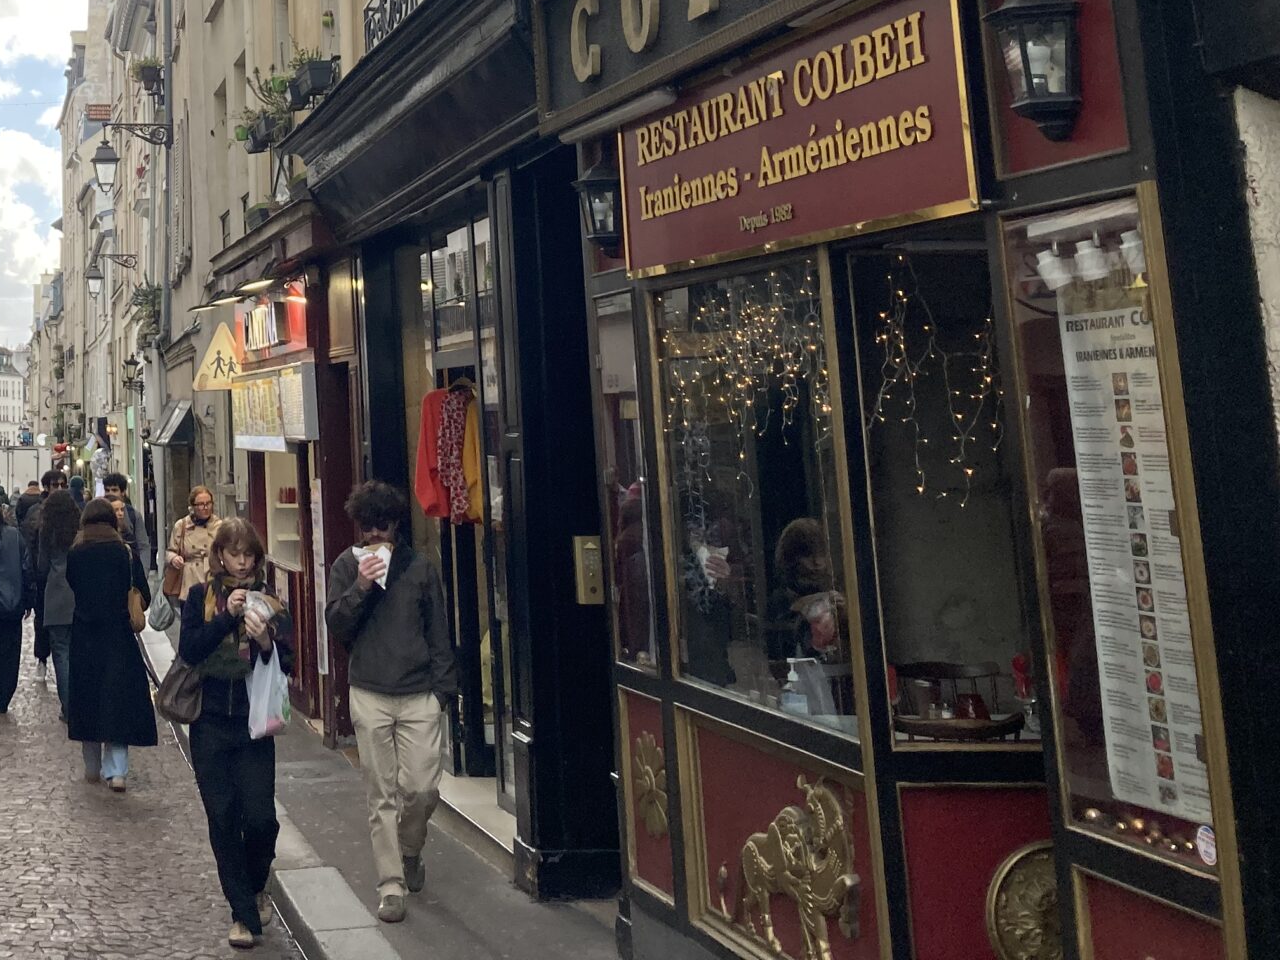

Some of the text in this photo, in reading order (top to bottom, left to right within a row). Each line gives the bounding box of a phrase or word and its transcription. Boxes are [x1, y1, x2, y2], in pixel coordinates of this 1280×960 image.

[636, 11, 926, 166] RESTAURANT COLBEH
[638, 166, 739, 220] Iraniennes
[758, 105, 932, 188] Arméniennes
[739, 210, 769, 234] Depuis
[1065, 315, 1125, 332] RESTAURANT
